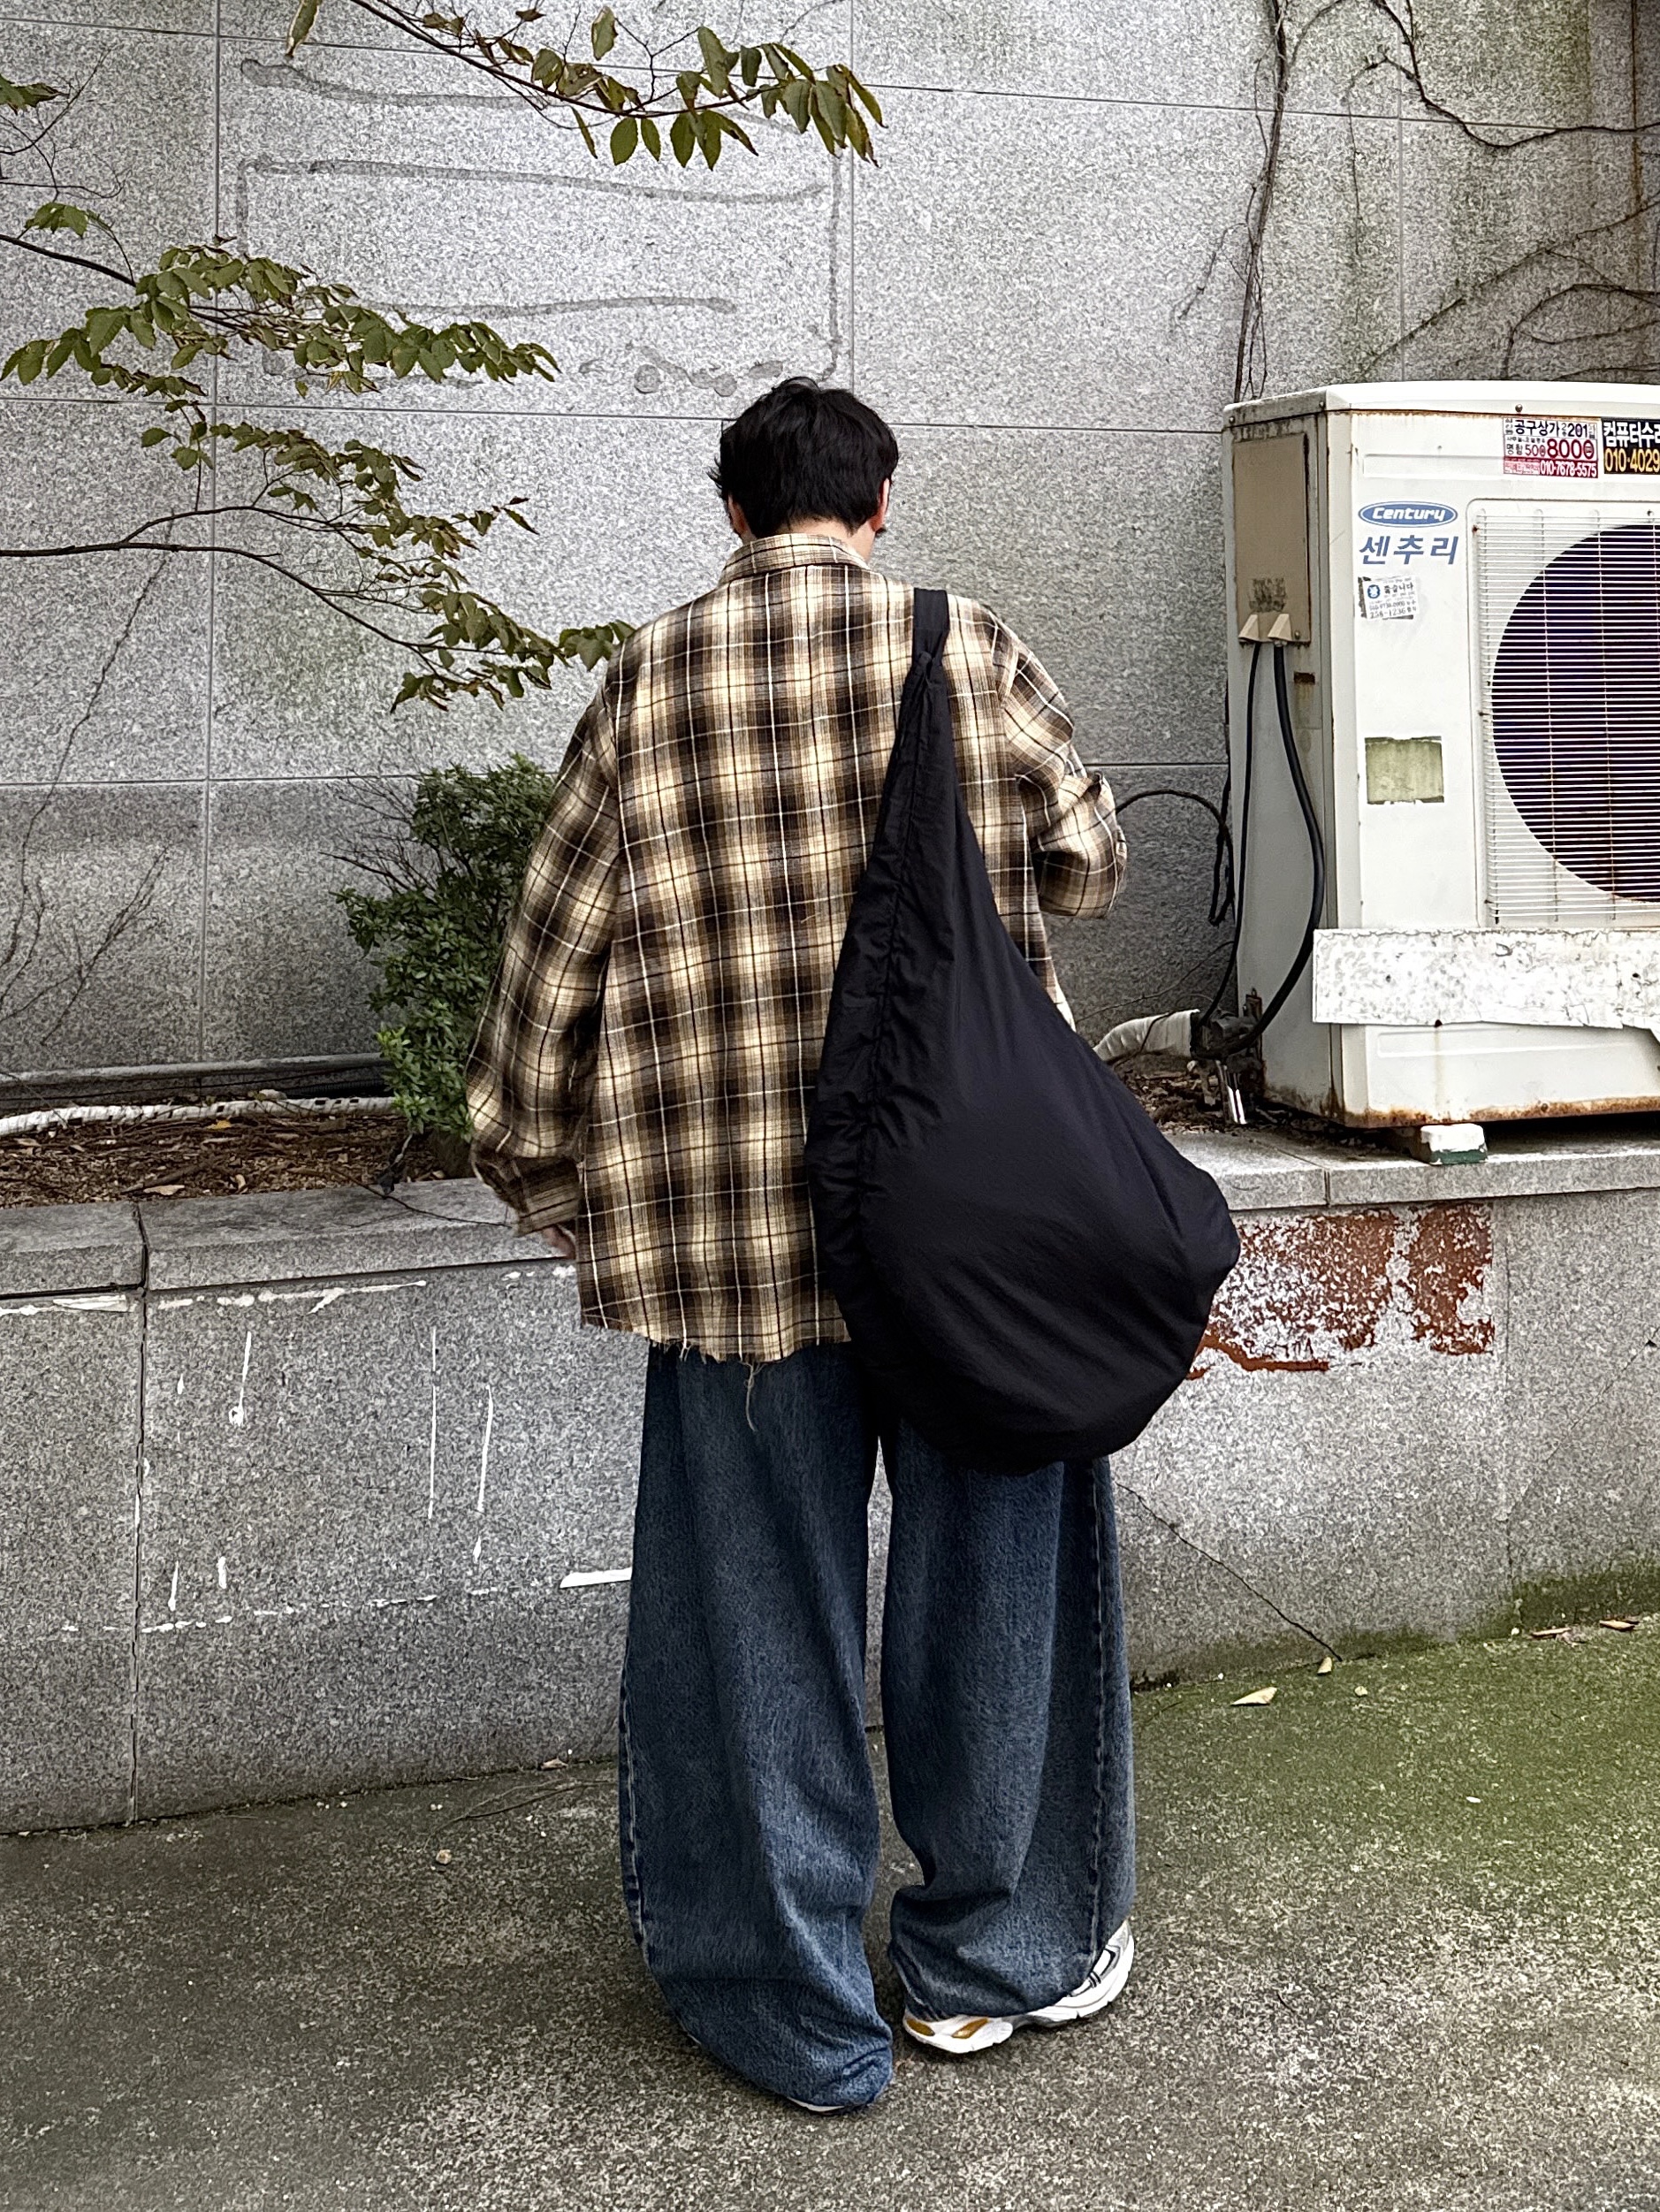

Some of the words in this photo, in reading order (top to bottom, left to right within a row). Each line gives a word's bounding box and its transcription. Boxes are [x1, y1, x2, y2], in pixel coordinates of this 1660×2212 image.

[1514, 420, 1559, 436] 공구상가
[1540, 460, 1597, 477] 010-7678-5575
[1372, 507, 1446, 521] Century
[1359, 535, 1458, 565] 센추리
